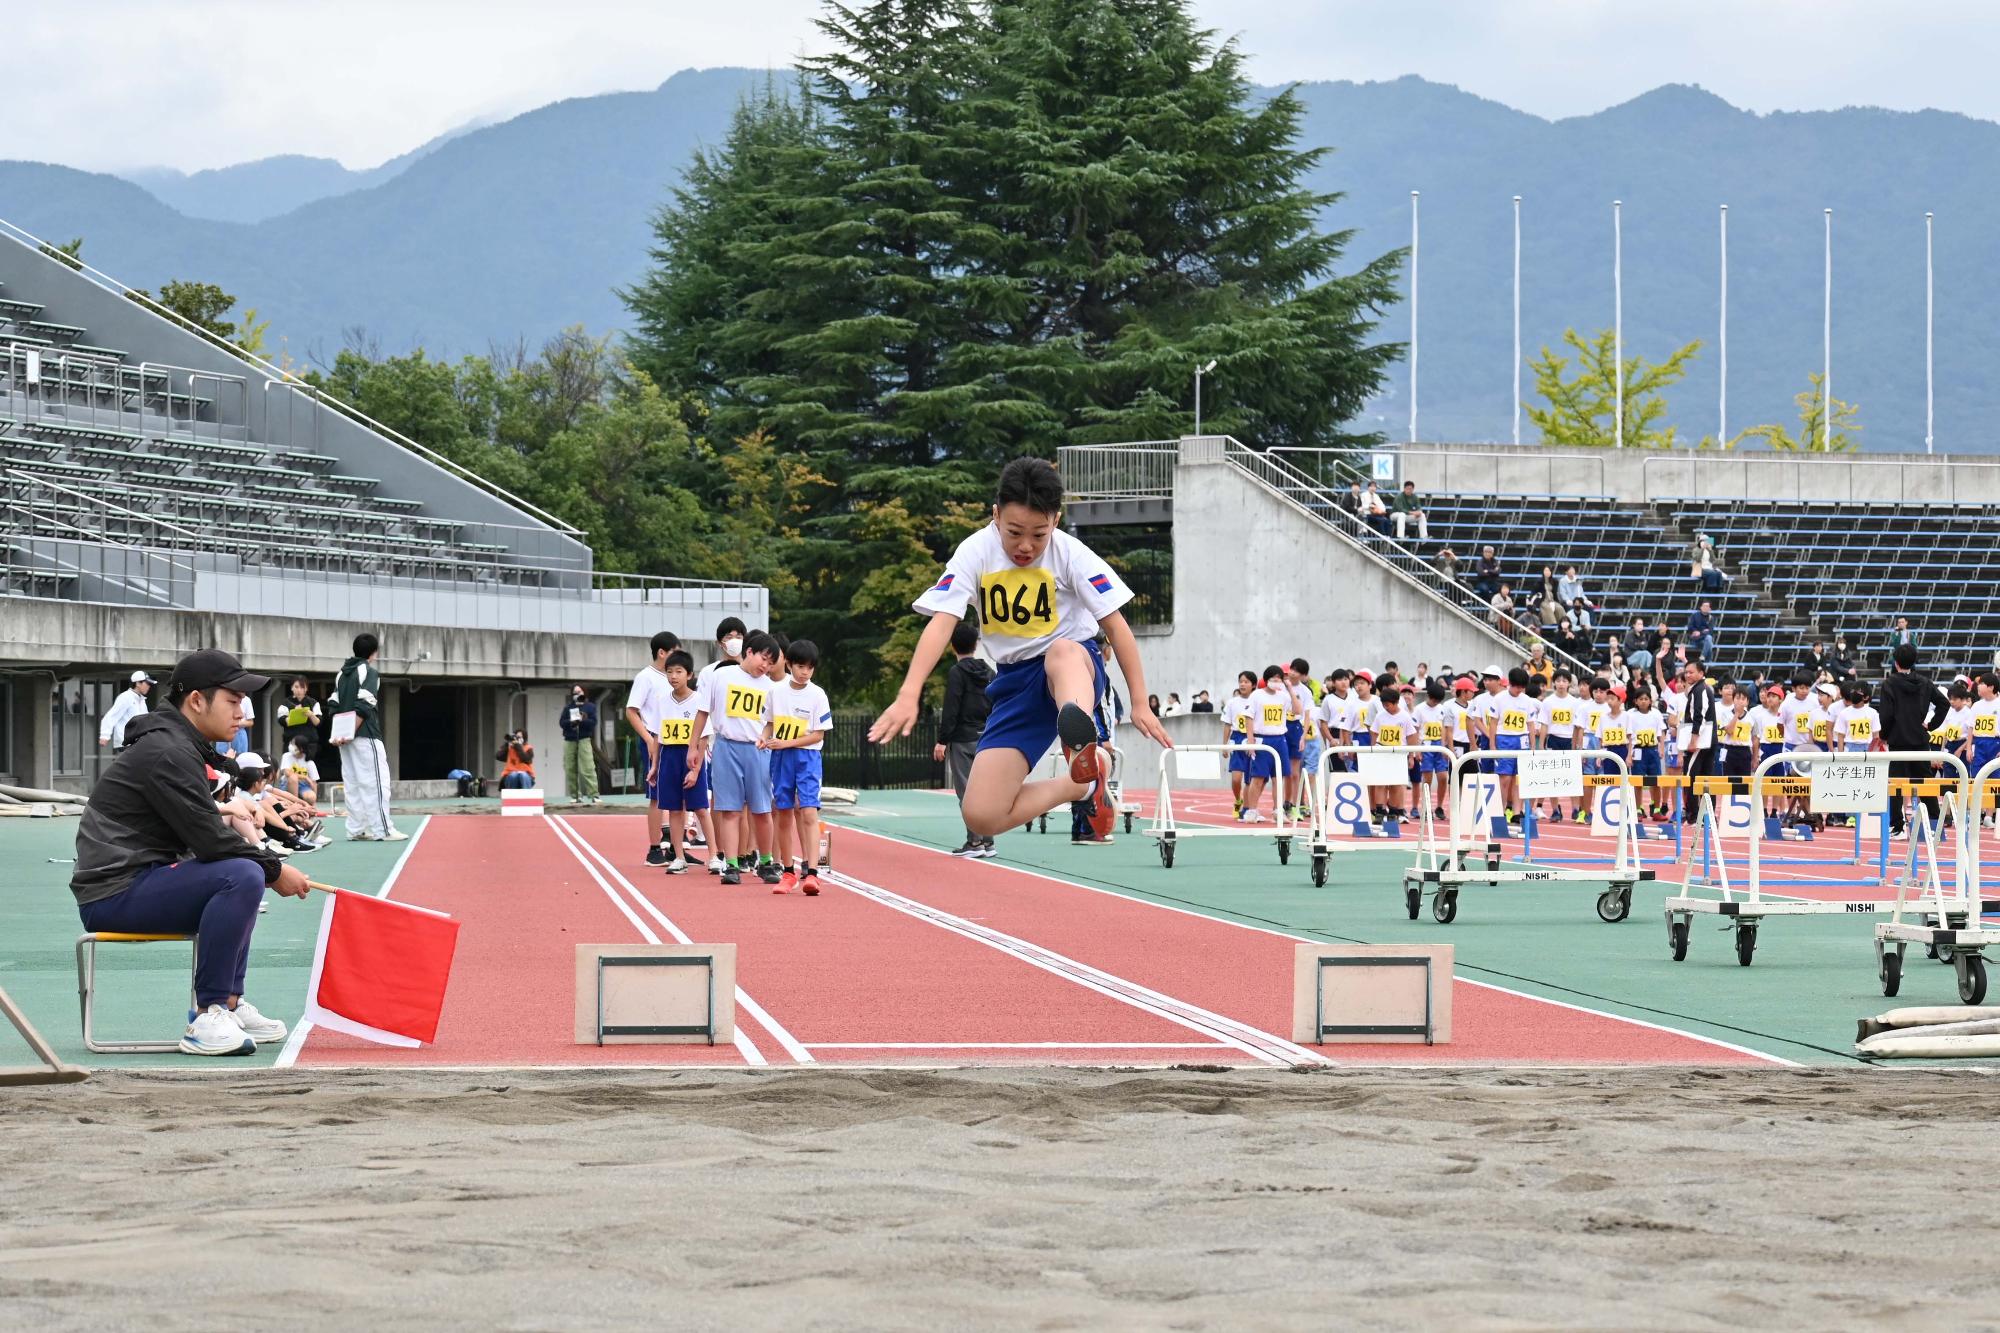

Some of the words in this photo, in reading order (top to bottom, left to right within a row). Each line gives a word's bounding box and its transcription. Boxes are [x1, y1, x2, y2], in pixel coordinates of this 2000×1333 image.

[1377, 458, 1389, 475] K
[980, 582, 1052, 625] 1064
[731, 690, 762, 715] 701
[1264, 708, 1283, 722] 1027
[1504, 713, 1525, 729] 449
[1552, 711, 1571, 722] 603
[663, 723, 691, 740] 343
[775, 722, 800, 741] 411
[1850, 722, 1870, 736] 749
[1974, 718, 1994, 731] 805
[1380, 728, 1400, 743] 1034
[1604, 730, 1623, 742] 333
[1636, 733, 1655, 746] 504
[1527, 758, 1571, 771] 小学生用
[1822, 765, 1876, 780] 小学生用
[1528, 777, 1572, 788] ハードル
[1591, 777, 1615, 785] NISHI
[1782, 785, 1810, 795] NISHI
[1822, 788, 1876, 802] ハードル
[1334, 781, 1363, 825] 8
[1467, 783, 1496, 825] 7
[1525, 872, 1550, 881] NISHI
[1846, 903, 1875, 913] NISHI
